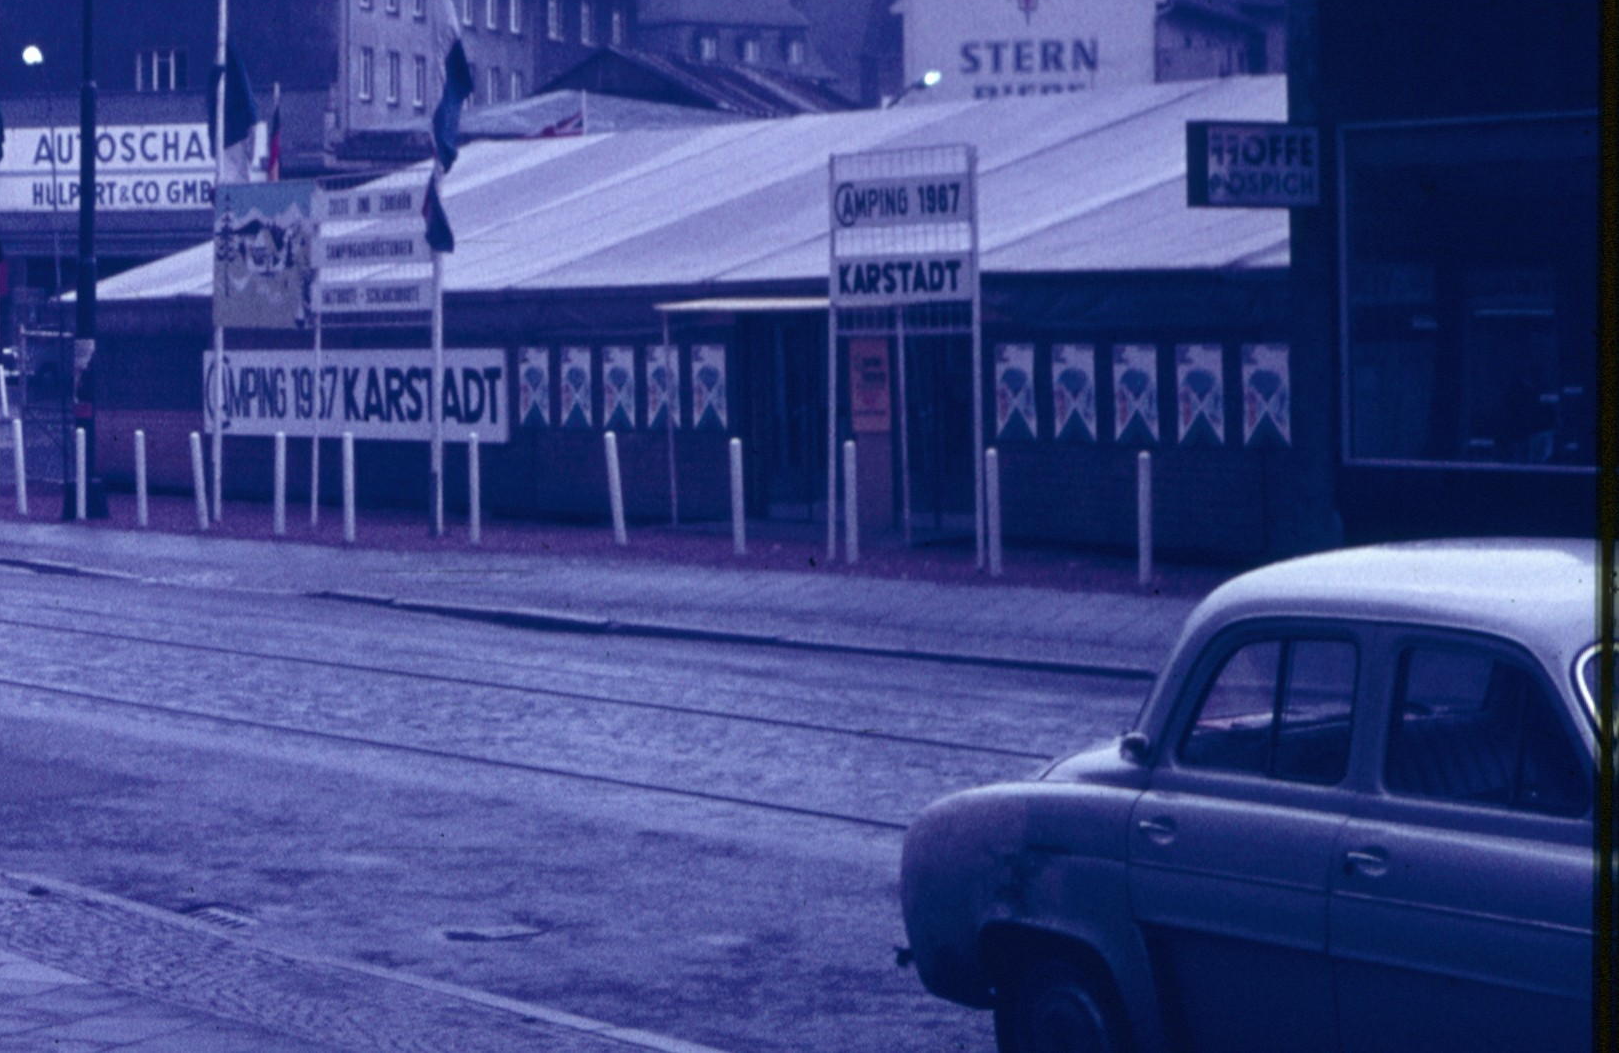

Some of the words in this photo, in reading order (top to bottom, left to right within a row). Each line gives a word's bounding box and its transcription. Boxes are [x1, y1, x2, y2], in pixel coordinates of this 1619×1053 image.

[959, 38, 1099, 74] STERN
[834, 182, 909, 227] CAMPING
[917, 182, 961, 214] 1967
[839, 260, 962, 295] KARSTADT
[343, 365, 502, 424] KARSTADT
